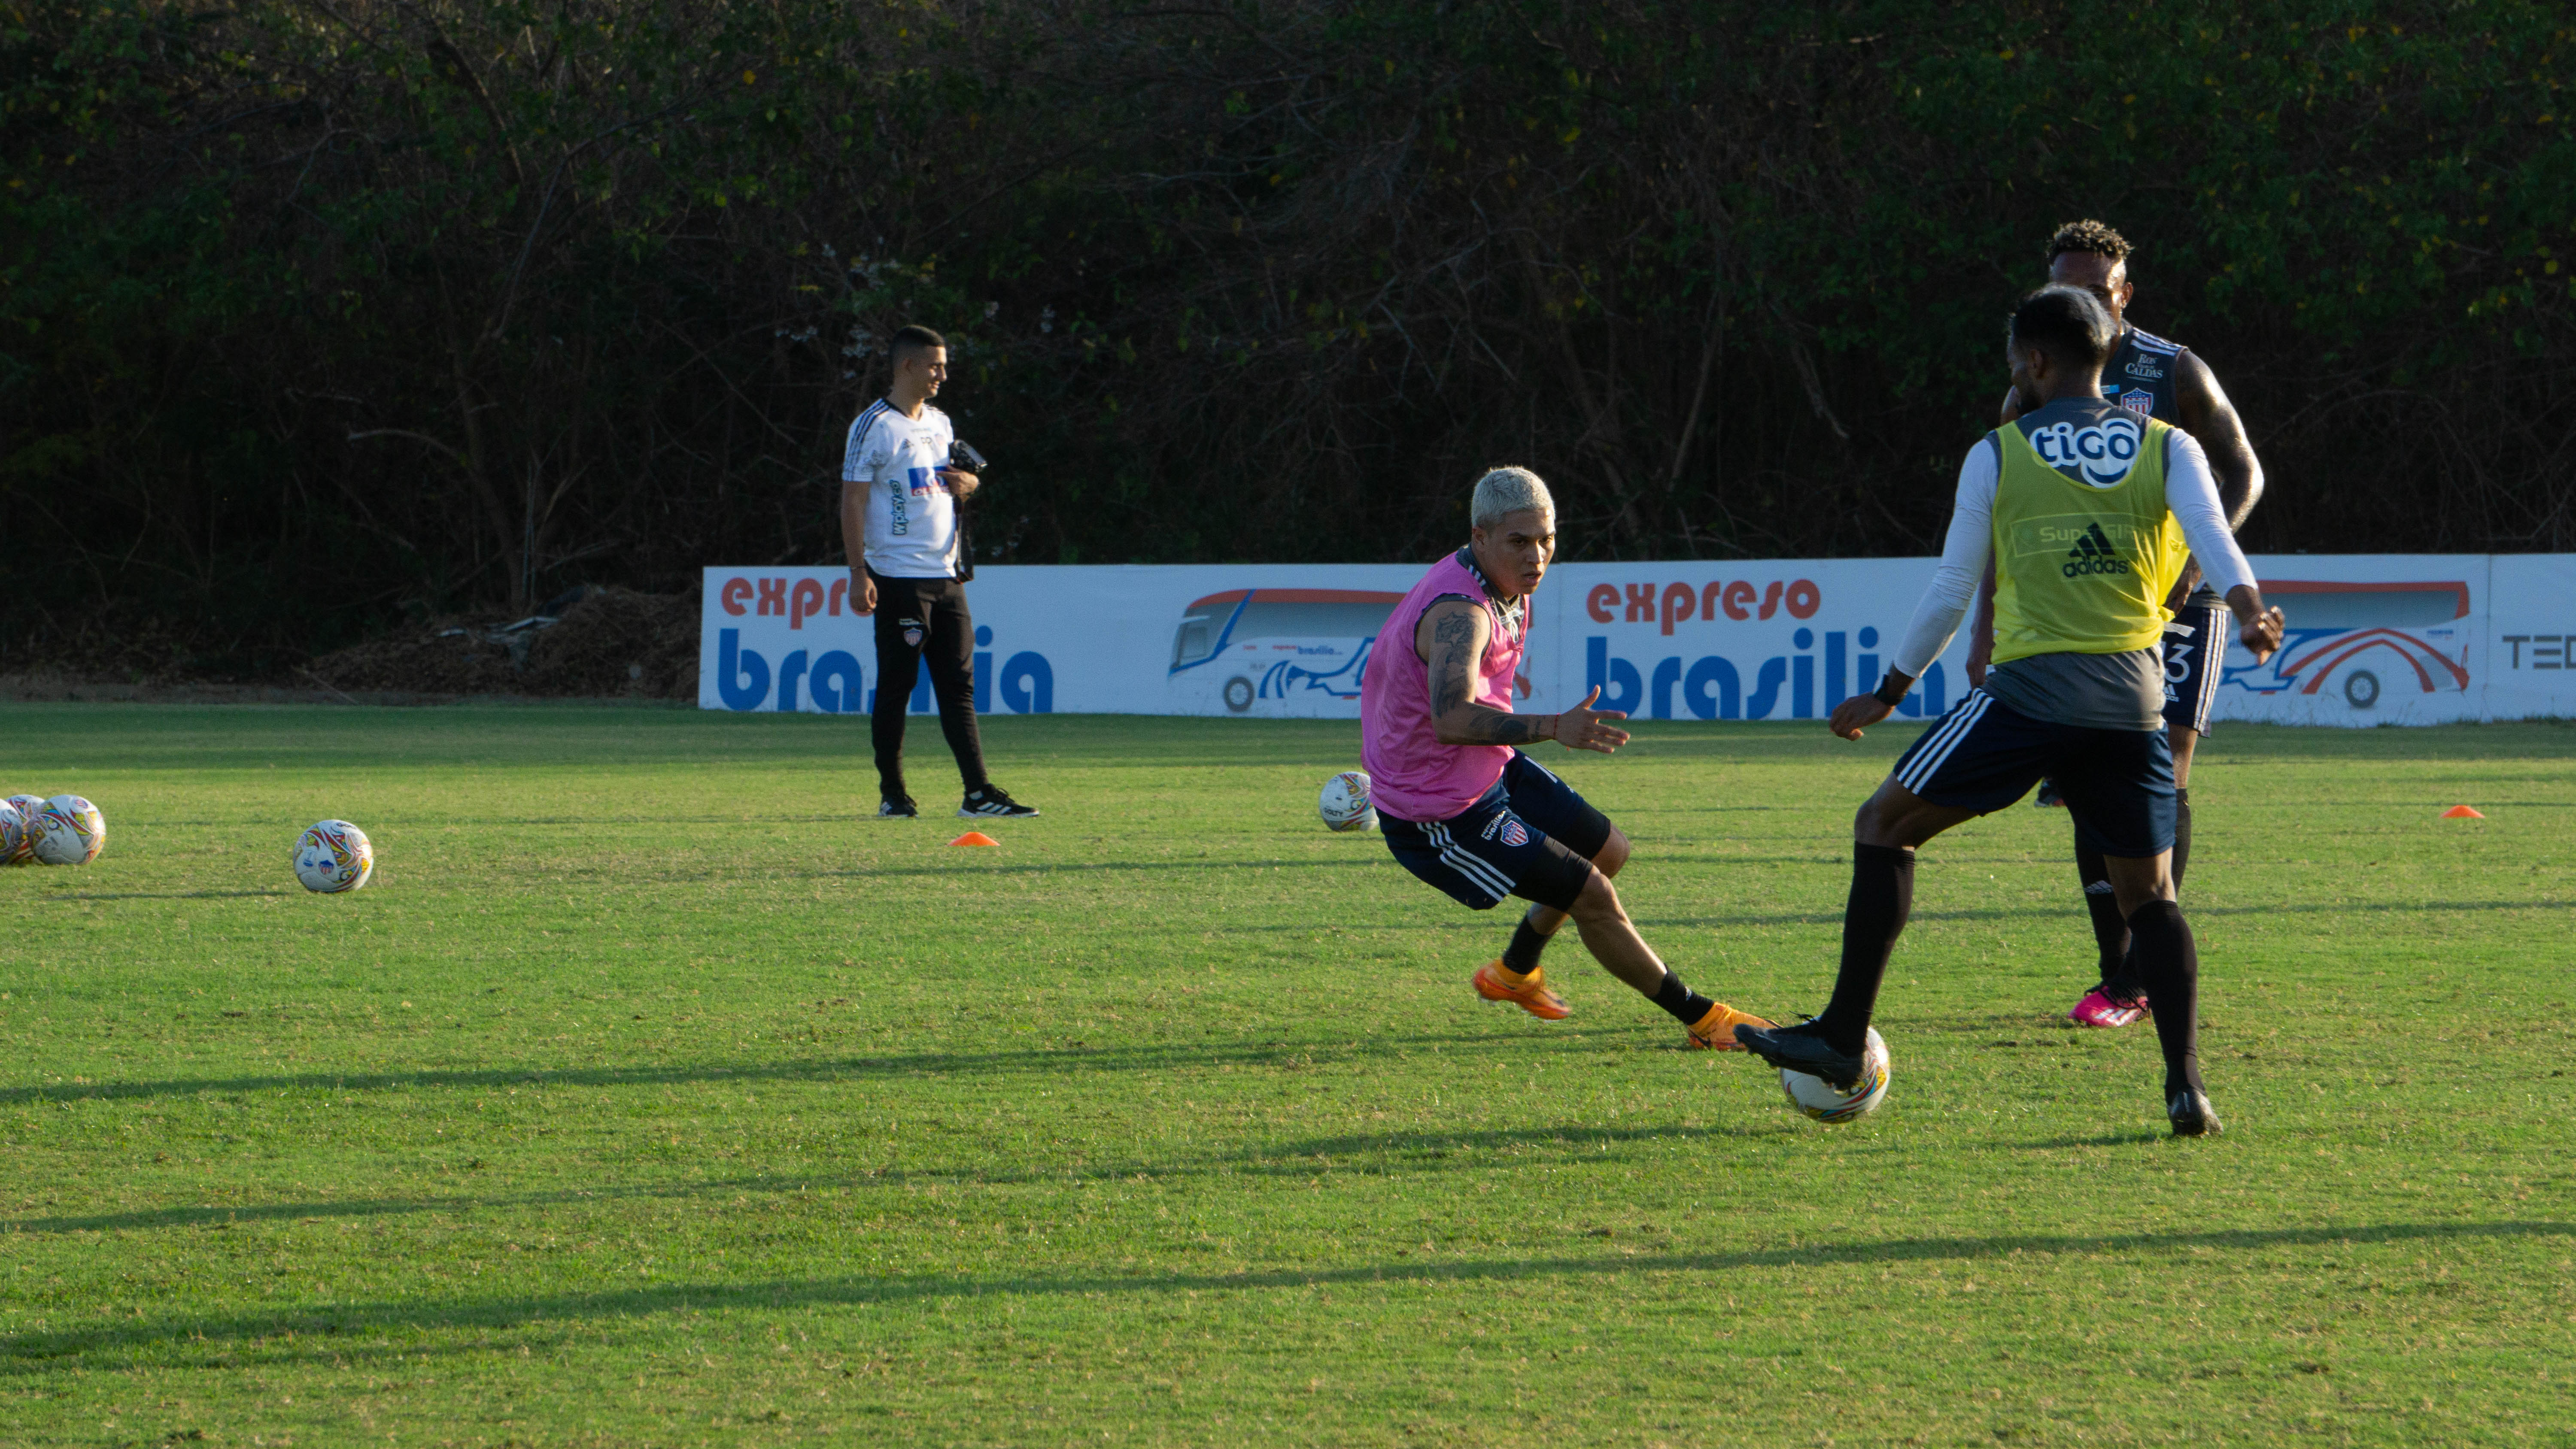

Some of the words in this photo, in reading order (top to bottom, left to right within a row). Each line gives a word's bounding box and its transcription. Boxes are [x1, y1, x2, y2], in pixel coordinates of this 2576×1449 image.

[2126, 363, 2163, 378] CALDAS
[2034, 421, 2137, 485] tigo
[2063, 555, 2128, 578] adidas
[1586, 579, 1821, 636] expreso
